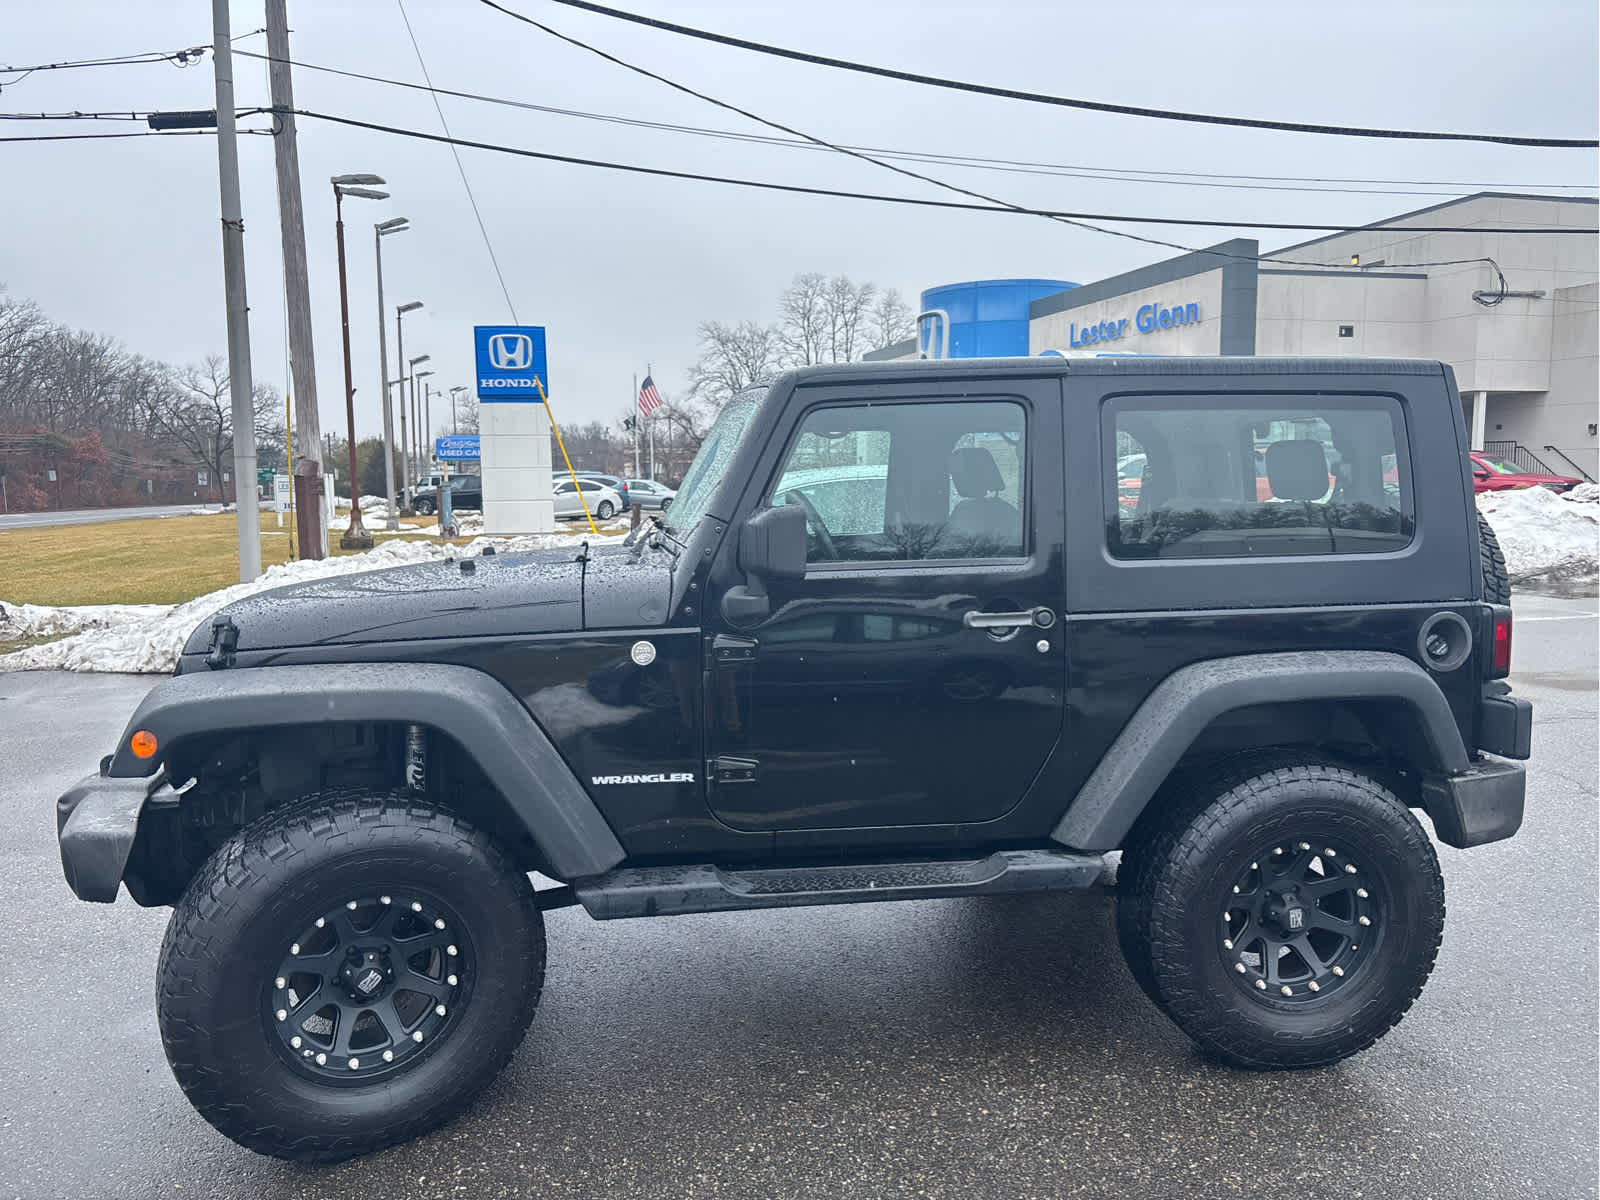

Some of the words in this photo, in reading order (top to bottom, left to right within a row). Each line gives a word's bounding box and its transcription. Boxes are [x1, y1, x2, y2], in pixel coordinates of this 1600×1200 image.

[1070, 318, 1127, 348] Lester
[1136, 302, 1199, 333] Glenn
[480, 379, 544, 388] HONDA
[592, 773, 695, 785] WRANGLER
